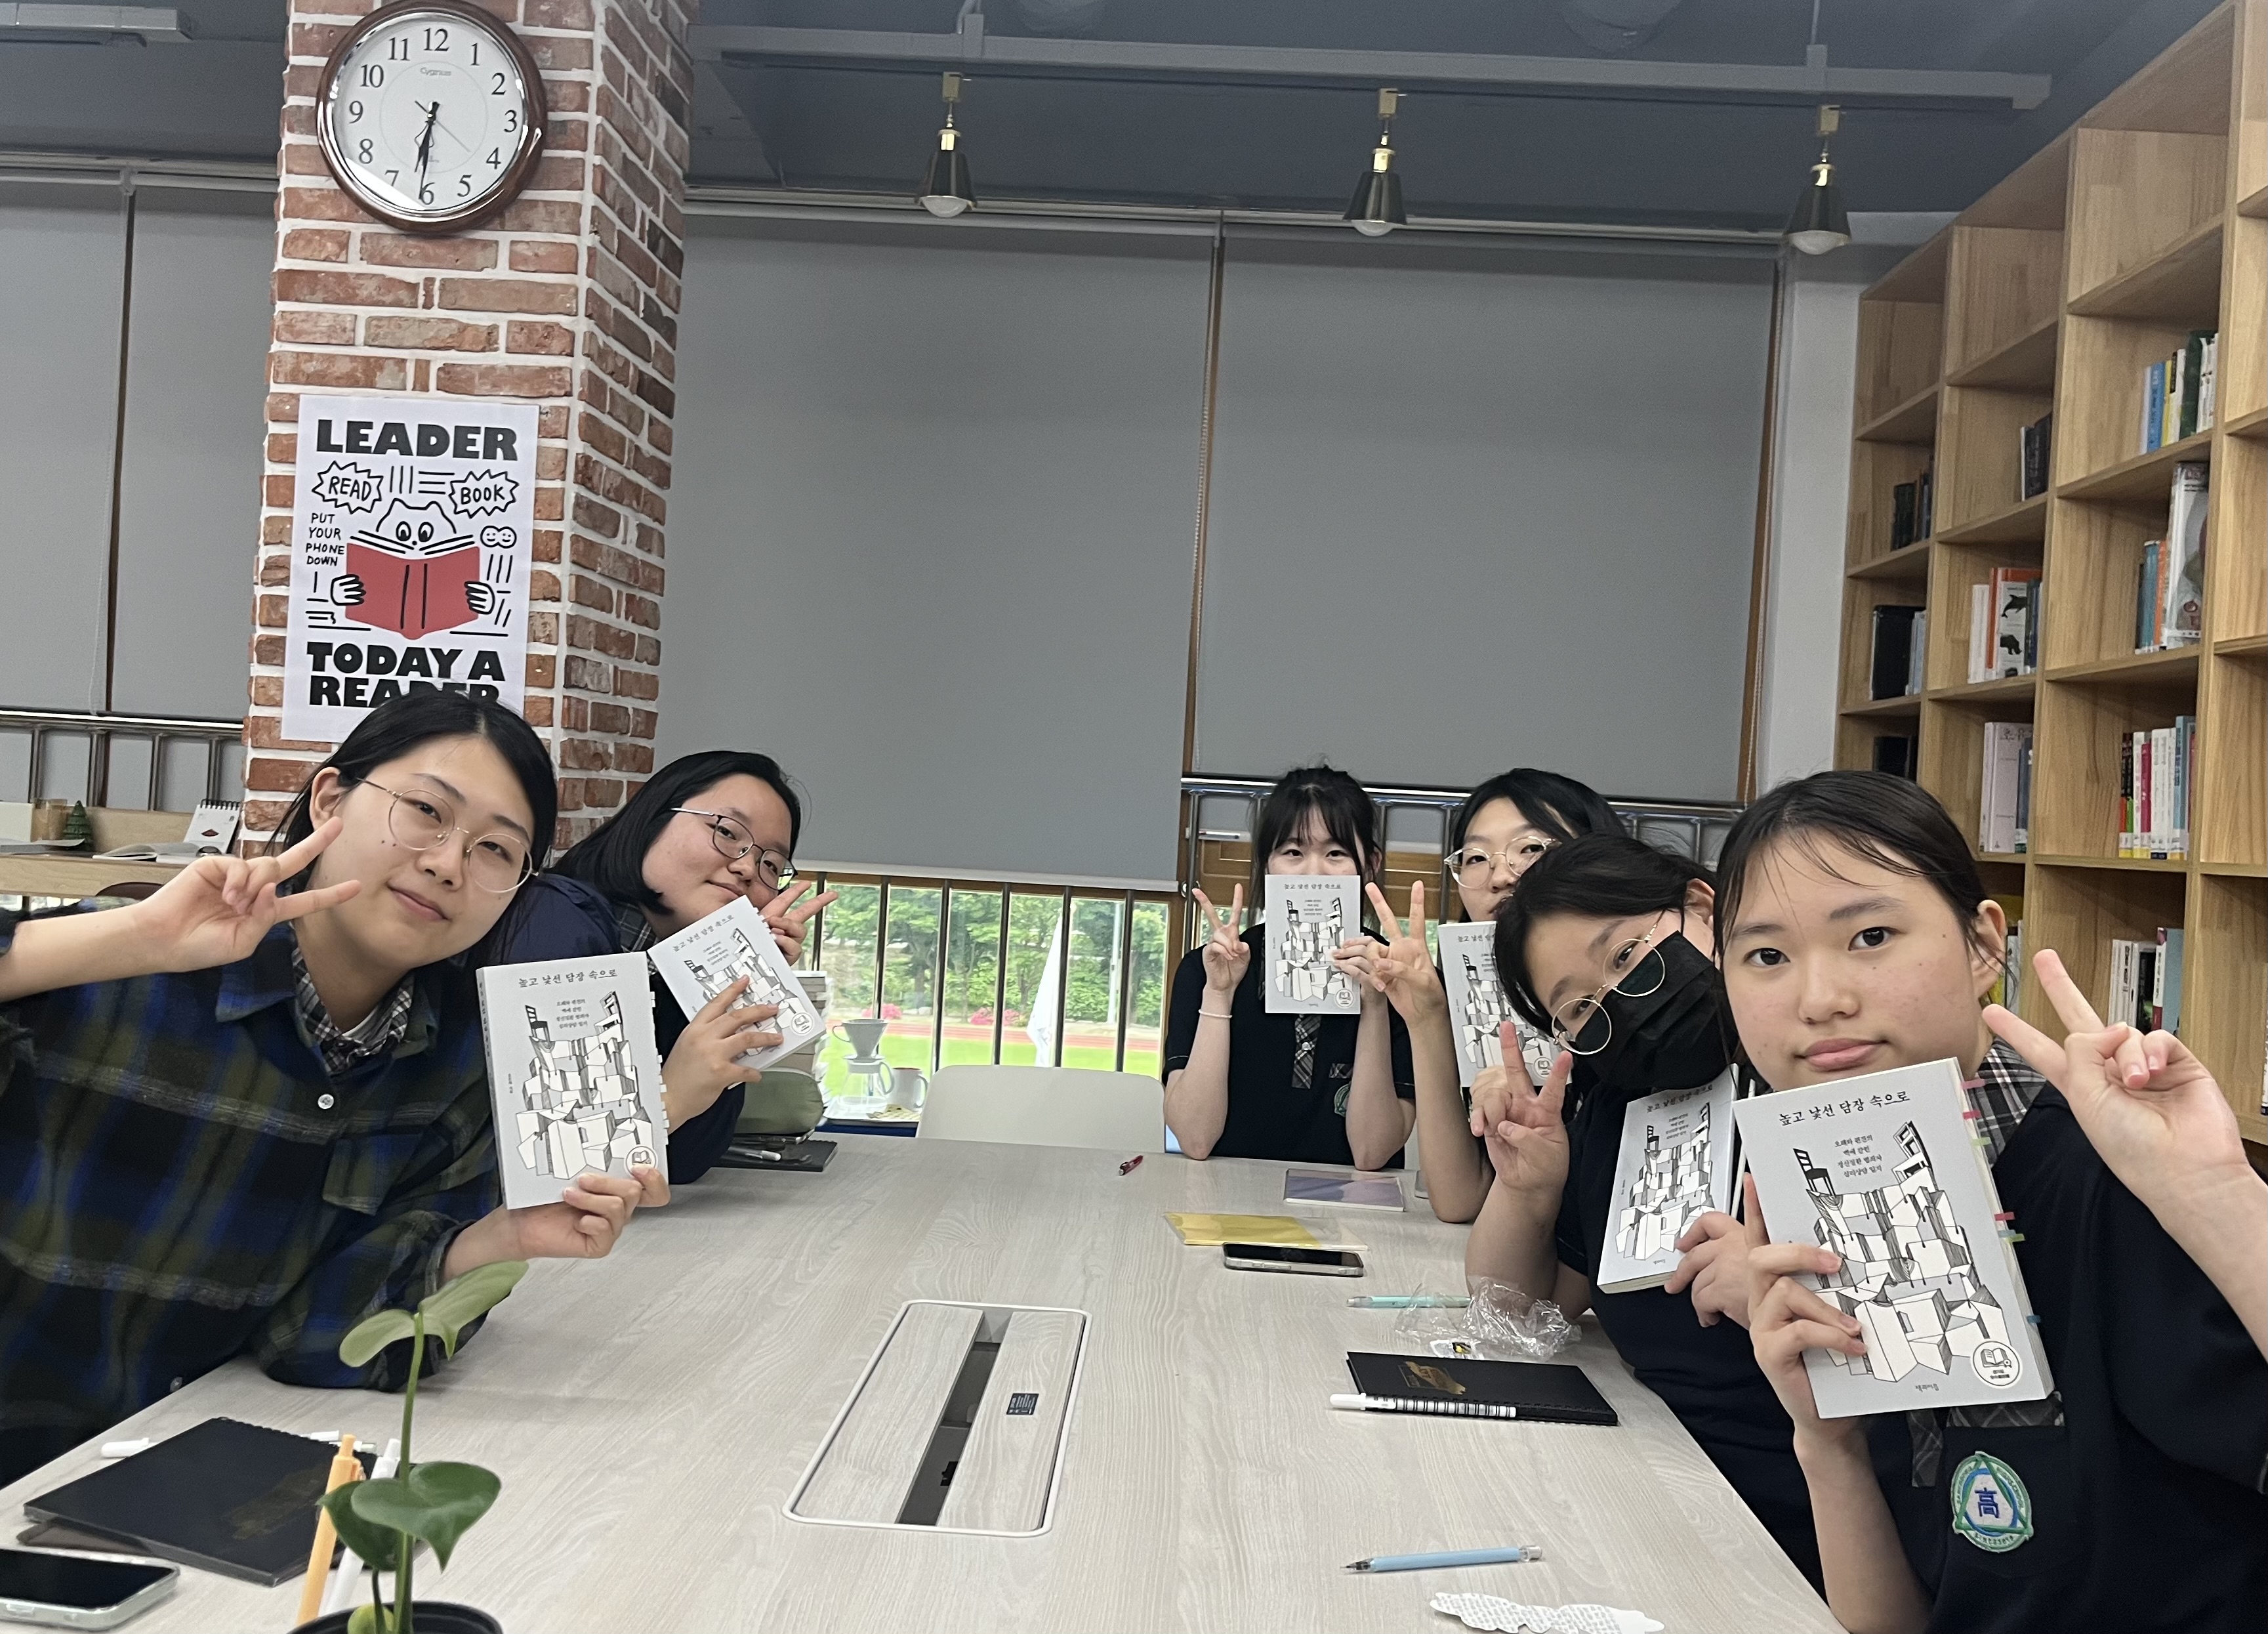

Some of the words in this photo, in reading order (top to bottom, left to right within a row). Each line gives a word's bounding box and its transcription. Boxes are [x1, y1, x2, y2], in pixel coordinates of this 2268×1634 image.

[388, 37, 411, 62] 11
[423, 28, 449, 52] 12
[470, 43, 480, 66] 1
[360, 64, 384, 88] 10
[491, 72, 506, 95] 2
[348, 100, 363, 124] 9
[503, 110, 517, 133] 3
[359, 138, 373, 164] 8
[486, 147, 501, 170] 4
[384, 169, 399, 186] 7
[457, 175, 472, 198] 5
[421, 182, 436, 205] 6
[316, 419, 518, 461] LEADER
[328, 476, 372, 501] READ
[460, 484, 505, 504] BOOK
[311, 513, 335, 525] PUT
[308, 527, 342, 541] YOUR
[306, 543, 345, 556] PHONE
[306, 555, 338, 567] DOWN
[306, 641, 464, 679] TODAY
[468, 650, 506, 682] A
[309, 675, 500, 709] REAR
[518, 978, 539, 988] 높고
[542, 974, 562, 985] 낯선
[566, 971, 585, 983] 담장
[588, 969, 617, 980] 속으로
[1779, 1112, 1805, 1126] 높고
[1809, 1104, 1836, 1120] 낯선
[1839, 1098, 1865, 1114] 담장
[1870, 1091, 1910, 1108] 속으로
